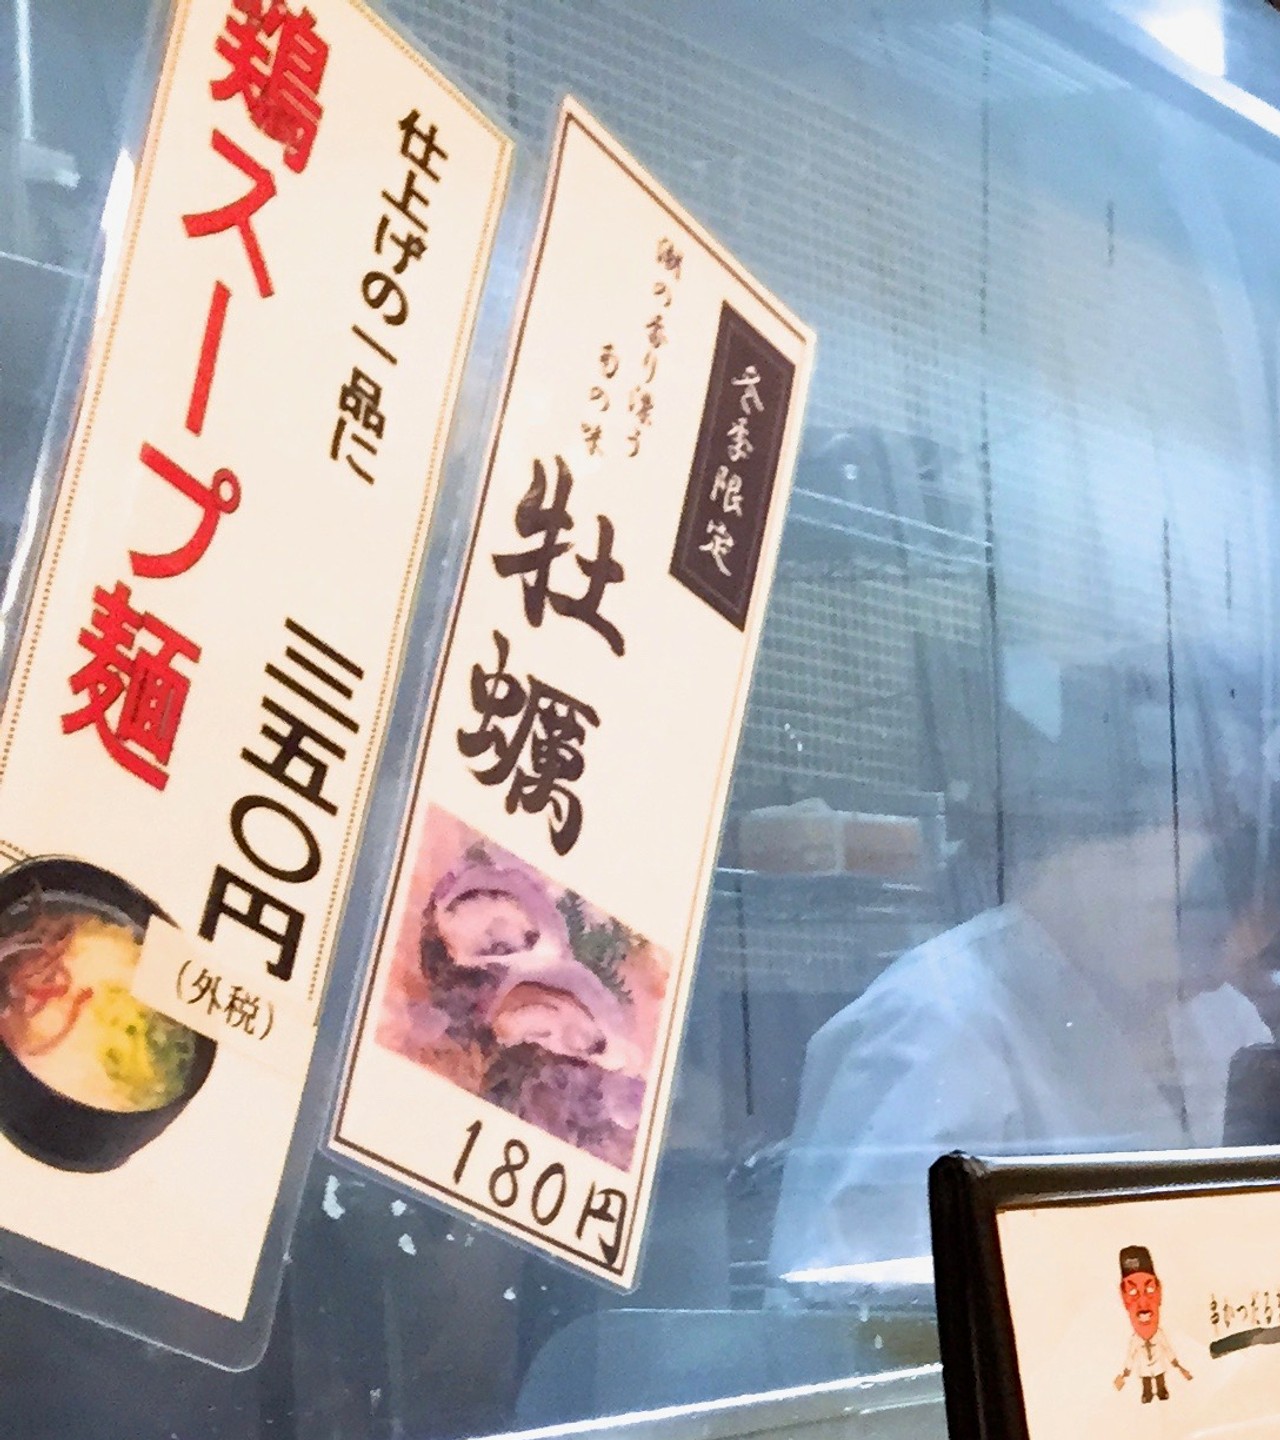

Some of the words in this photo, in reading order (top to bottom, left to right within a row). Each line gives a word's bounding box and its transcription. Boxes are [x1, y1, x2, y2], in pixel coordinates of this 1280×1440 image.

[61, 0, 329, 791] 鶏スープ麺
[330, 109, 448, 486] 仕上げの一品に
[457, 455, 627, 857] 牡蠣
[453, 1119, 629, 1267] 180円
